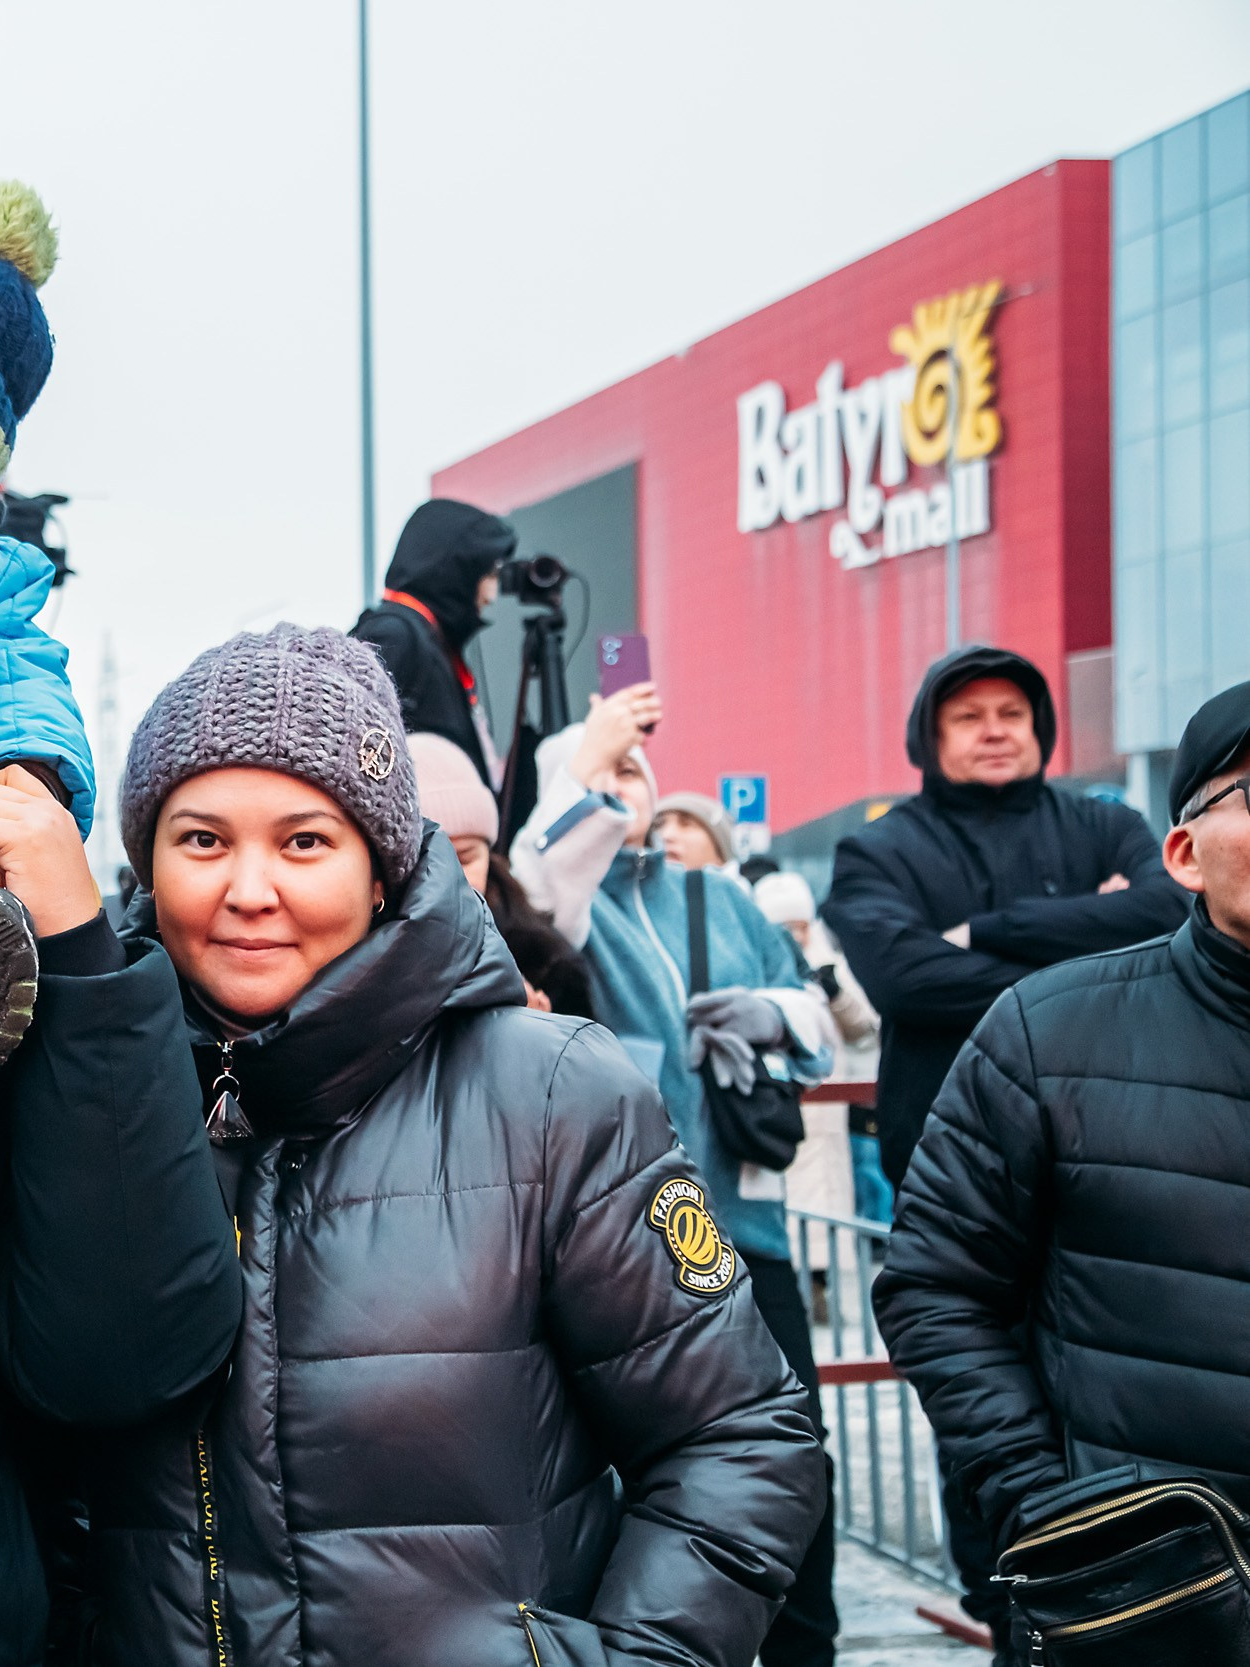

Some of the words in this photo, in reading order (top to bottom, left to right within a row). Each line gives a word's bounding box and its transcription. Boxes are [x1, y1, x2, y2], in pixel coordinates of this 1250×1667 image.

[736, 359, 916, 534] Batyr
[881, 461, 991, 558] mall
[729, 777, 757, 822] P
[654, 1183, 699, 1220] FASHION
[688, 1272, 721, 1288] SINCE
[717, 1252, 732, 1282] 2020
